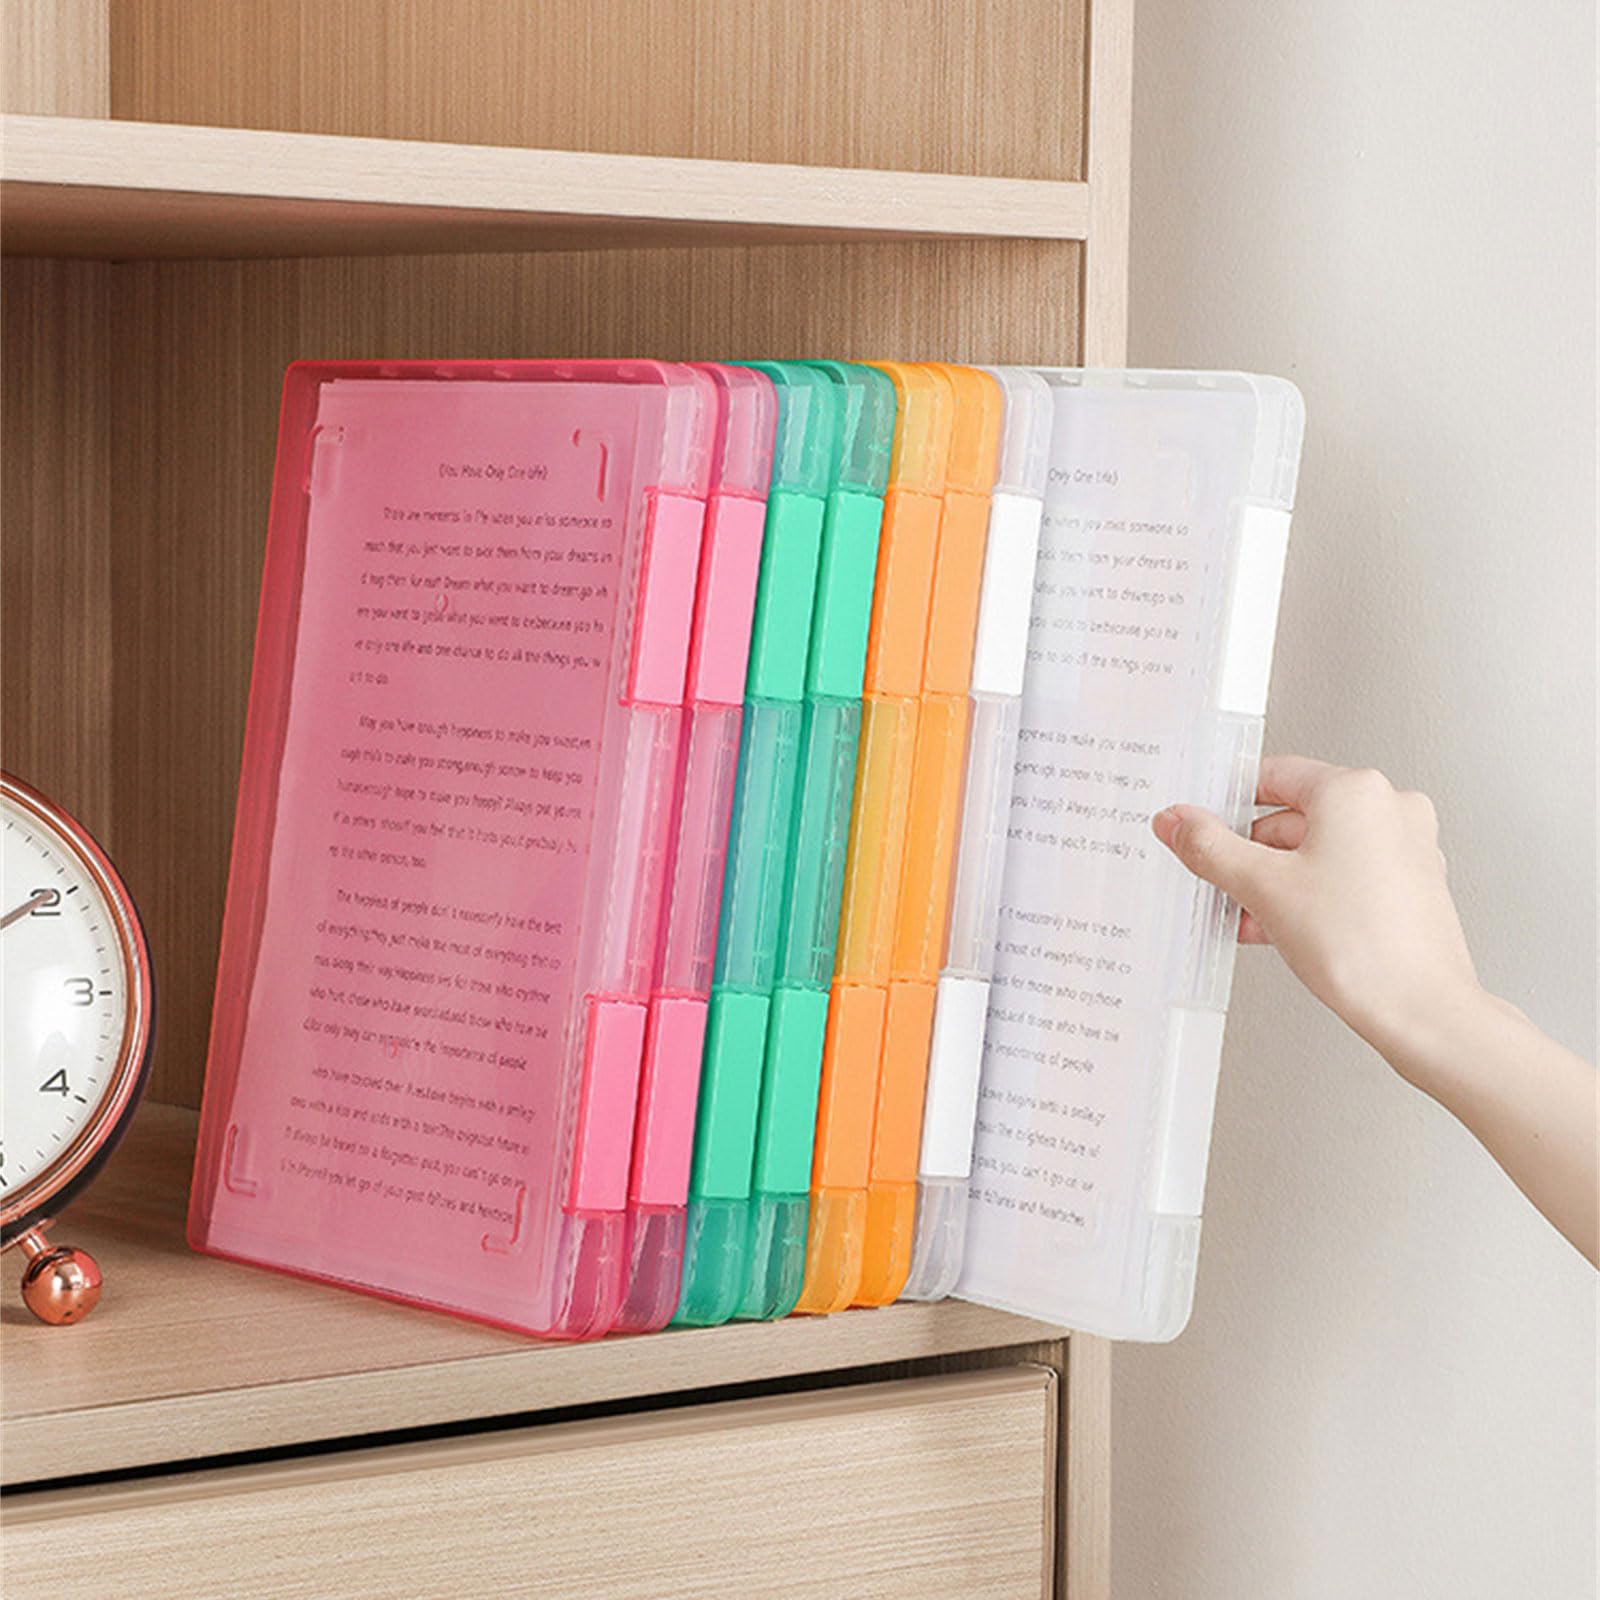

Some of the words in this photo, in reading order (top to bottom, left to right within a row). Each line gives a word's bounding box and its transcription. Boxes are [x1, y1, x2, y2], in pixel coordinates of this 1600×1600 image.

[30, 888, 62, 917] 2
[64, 977, 94, 1006] 3
[39, 1068, 70, 1097] 4
